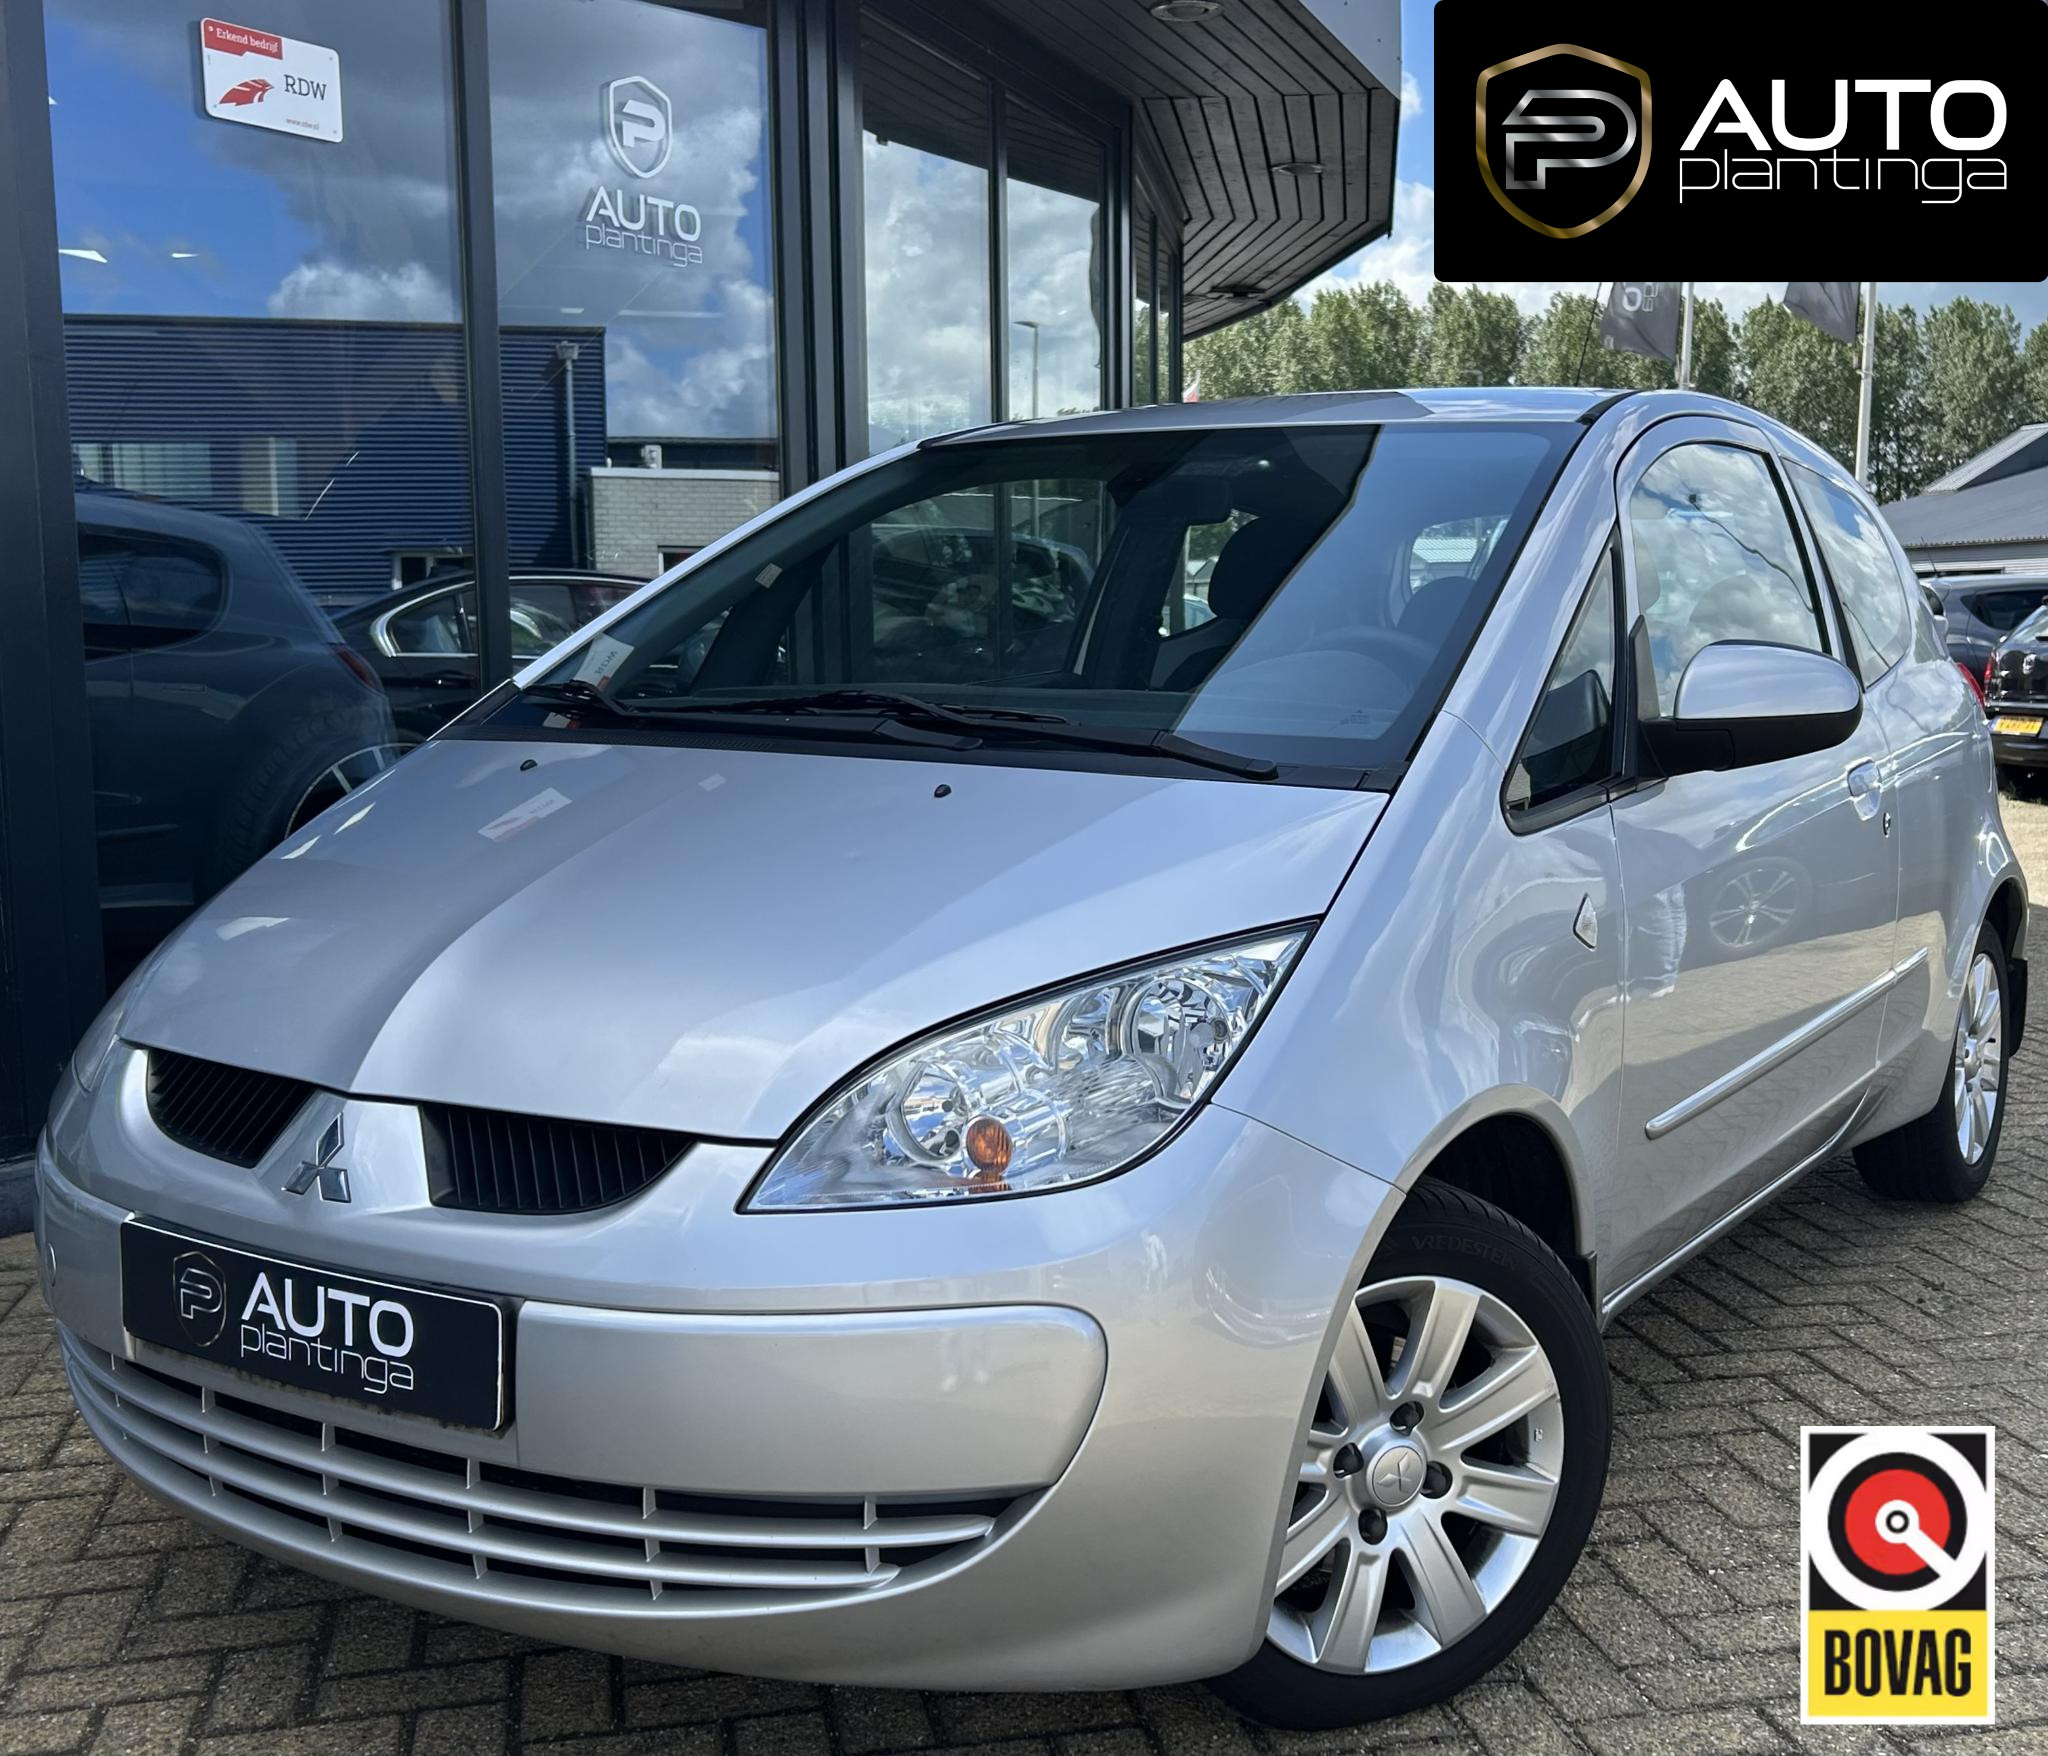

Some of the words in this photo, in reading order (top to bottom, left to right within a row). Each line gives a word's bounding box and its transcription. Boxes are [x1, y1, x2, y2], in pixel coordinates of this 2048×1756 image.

[215, 27, 249, 45] Erkend
[249, 35, 279, 53] bedrijf
[284, 74, 327, 101] RDW
[586, 185, 702, 242] AUTO
[585, 223, 703, 268] plantinga
[1411, 1234, 1516, 1271] VREDESTEIN
[241, 1271, 415, 1358] AUTO
[240, 1323, 415, 1394] plantinga
